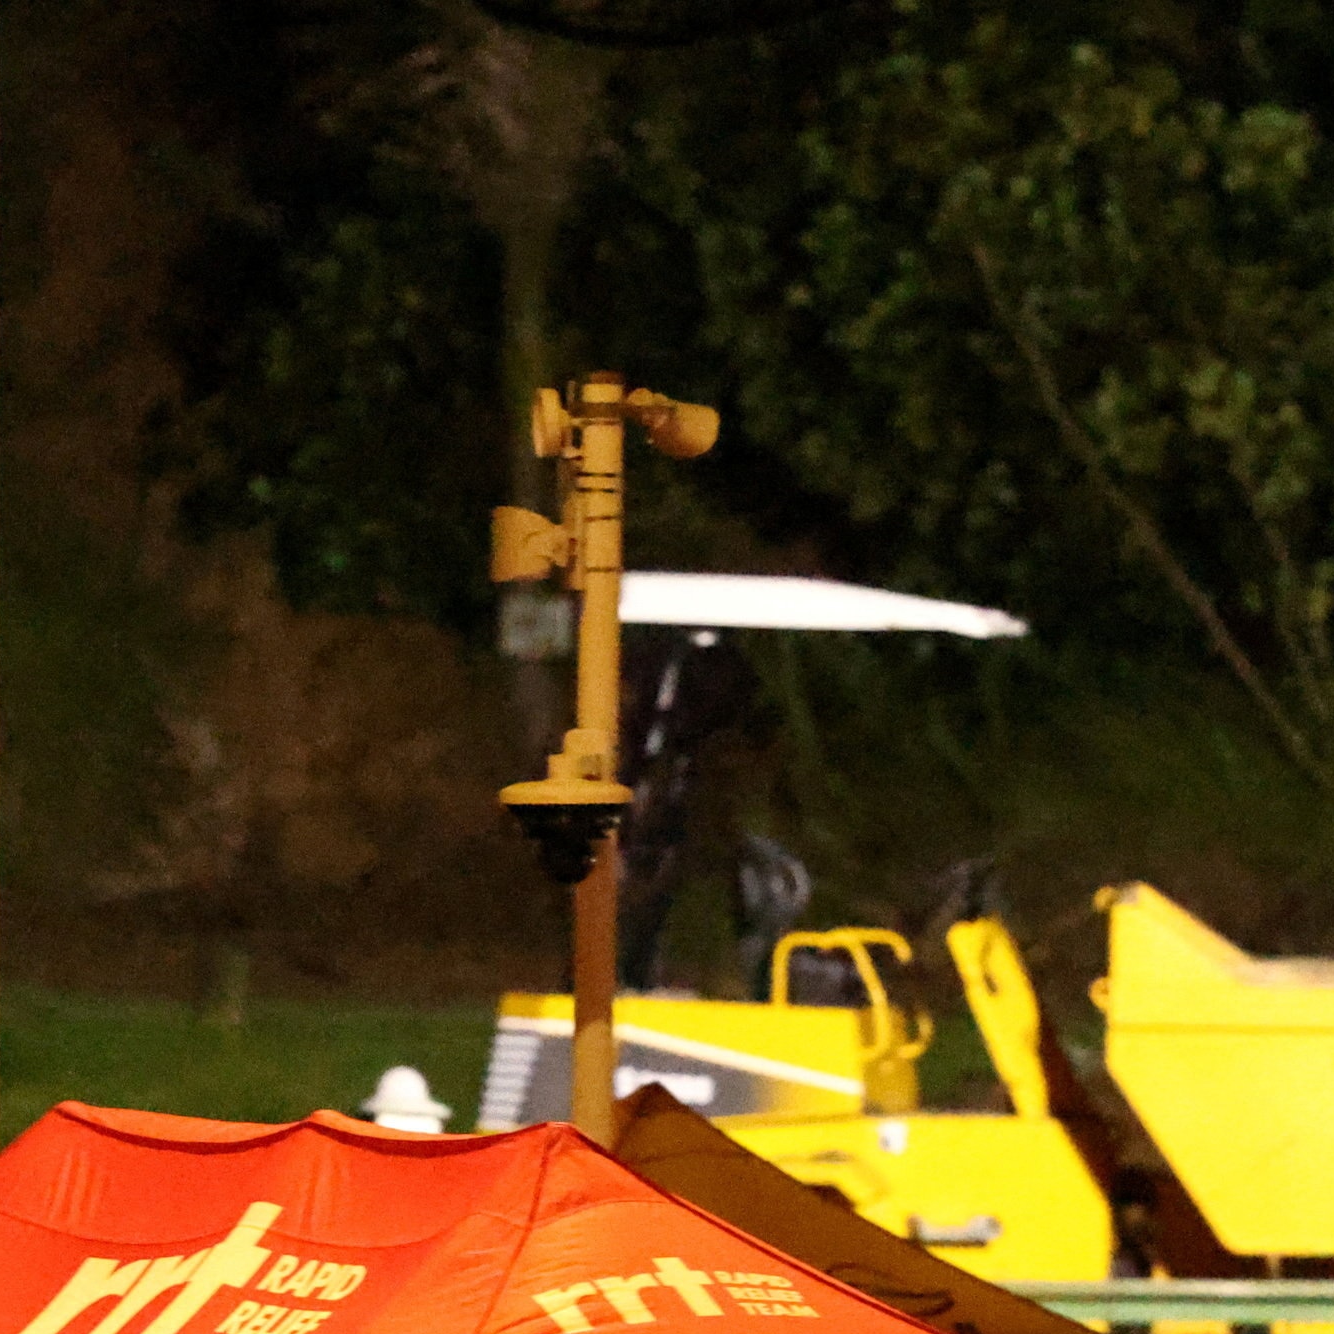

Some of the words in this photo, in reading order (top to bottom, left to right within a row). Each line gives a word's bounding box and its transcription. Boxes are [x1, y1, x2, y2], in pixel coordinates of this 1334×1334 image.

[260, 1253, 367, 1301] RAPID
[531, 1256, 724, 1334] rrt
[735, 1301, 821, 1318] TEAM
